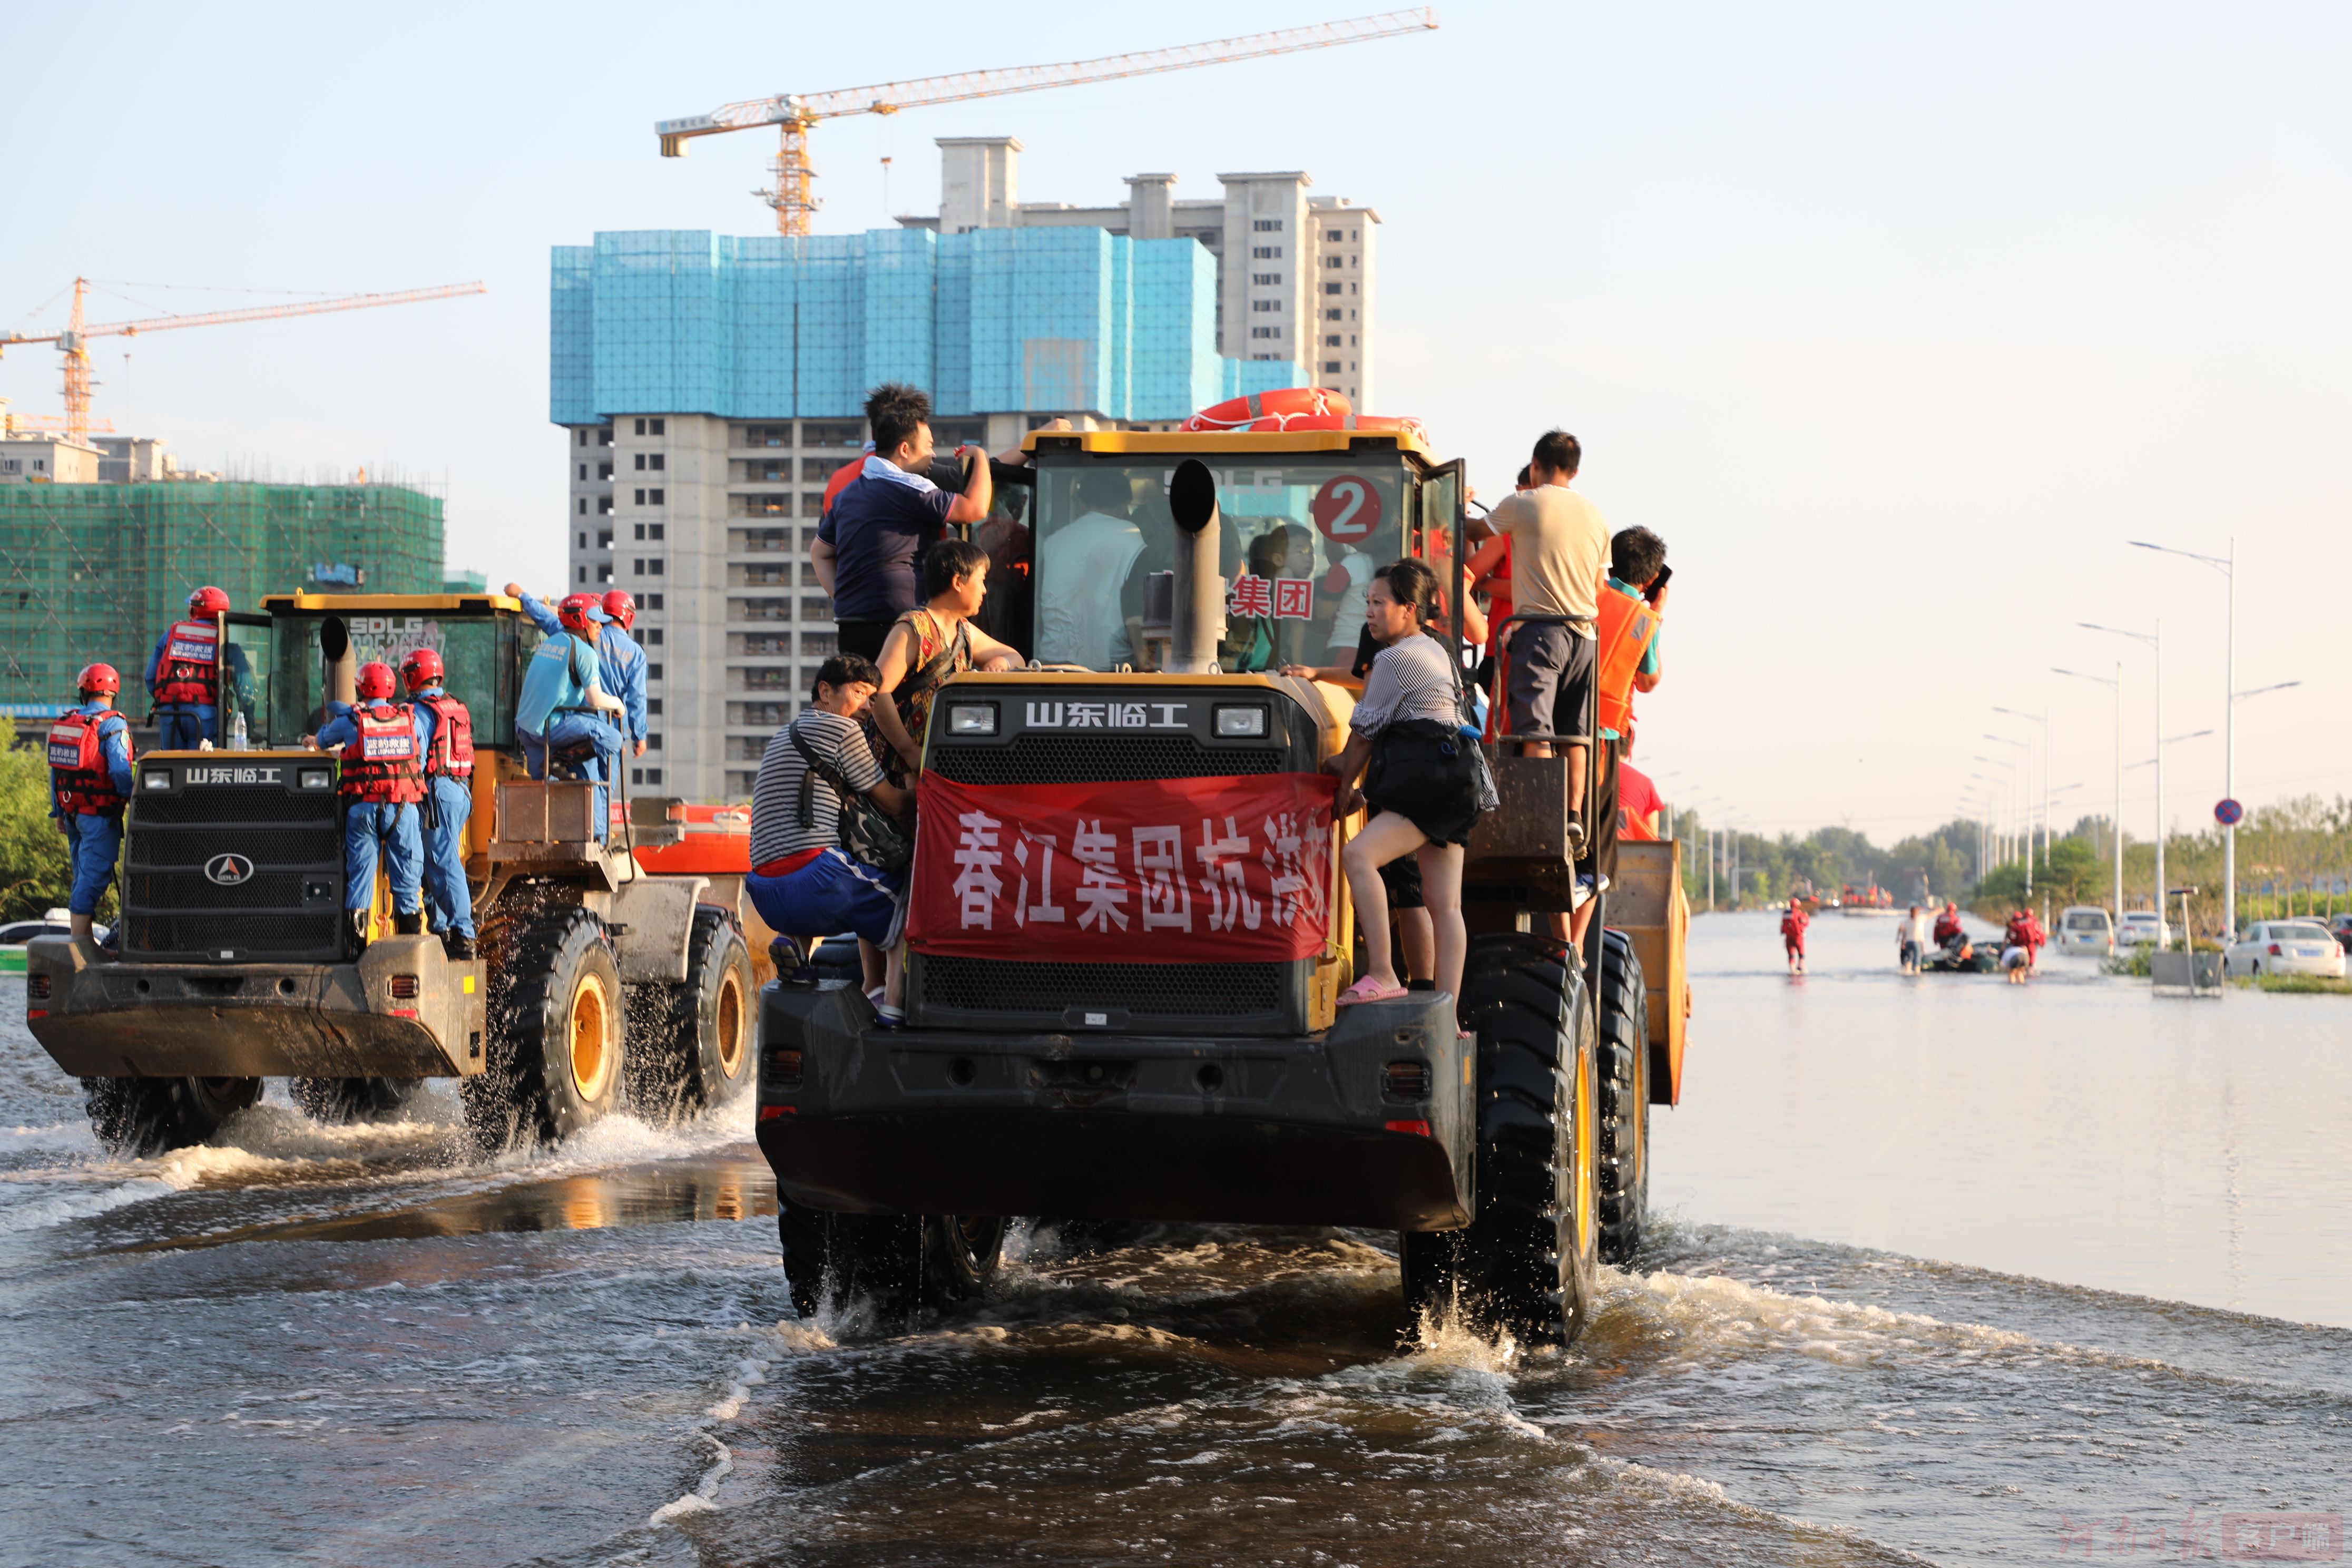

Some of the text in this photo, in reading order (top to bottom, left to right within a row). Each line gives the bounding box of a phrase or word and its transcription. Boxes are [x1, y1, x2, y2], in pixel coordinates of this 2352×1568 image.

[1163, 469, 1282, 495] LG
[1330, 481, 1367, 534] 2
[1224, 574, 1314, 621] 集团
[350, 617, 423, 634] SDLG
[1026, 702, 1189, 729] 山东临工
[186, 768, 281, 784] 山东临工
